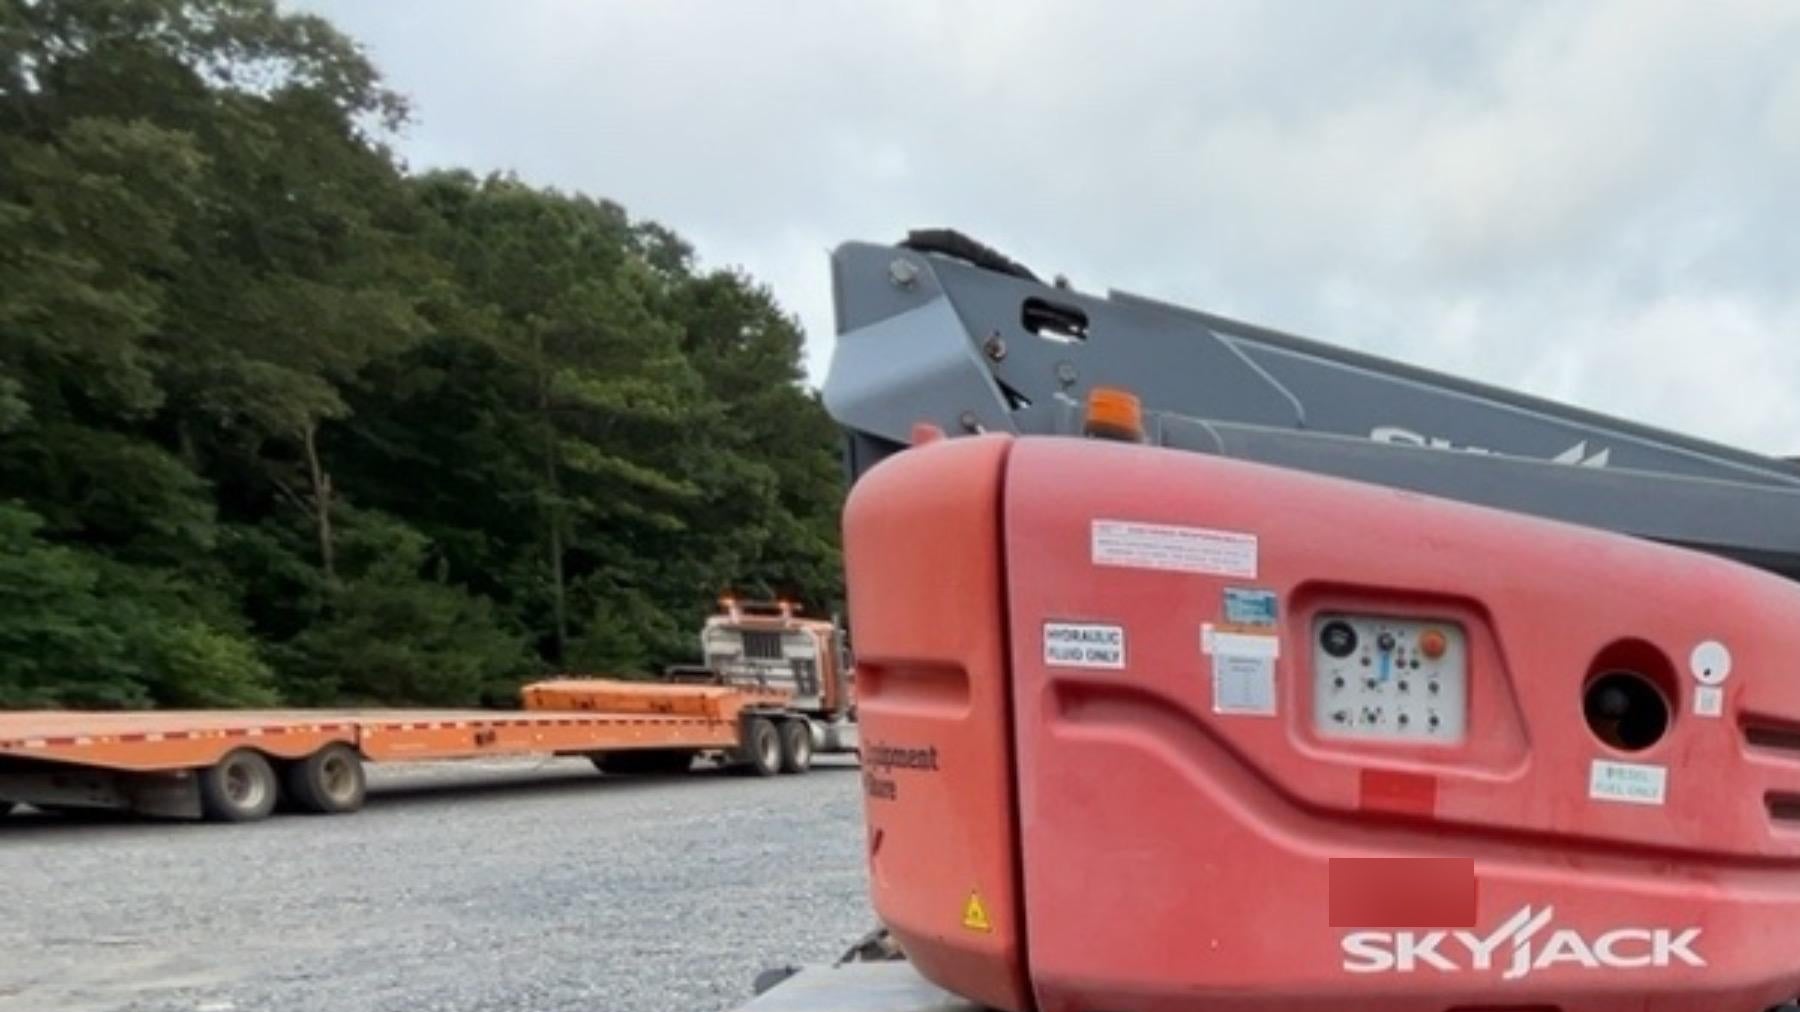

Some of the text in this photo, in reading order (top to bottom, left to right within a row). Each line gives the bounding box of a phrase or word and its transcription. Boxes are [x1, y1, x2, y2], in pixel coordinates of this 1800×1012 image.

[1047, 628, 1120, 646] HYDRAULIC
[1048, 646, 1120, 663] FLUID ONLY
[1340, 903, 1708, 981] SKYJACK
